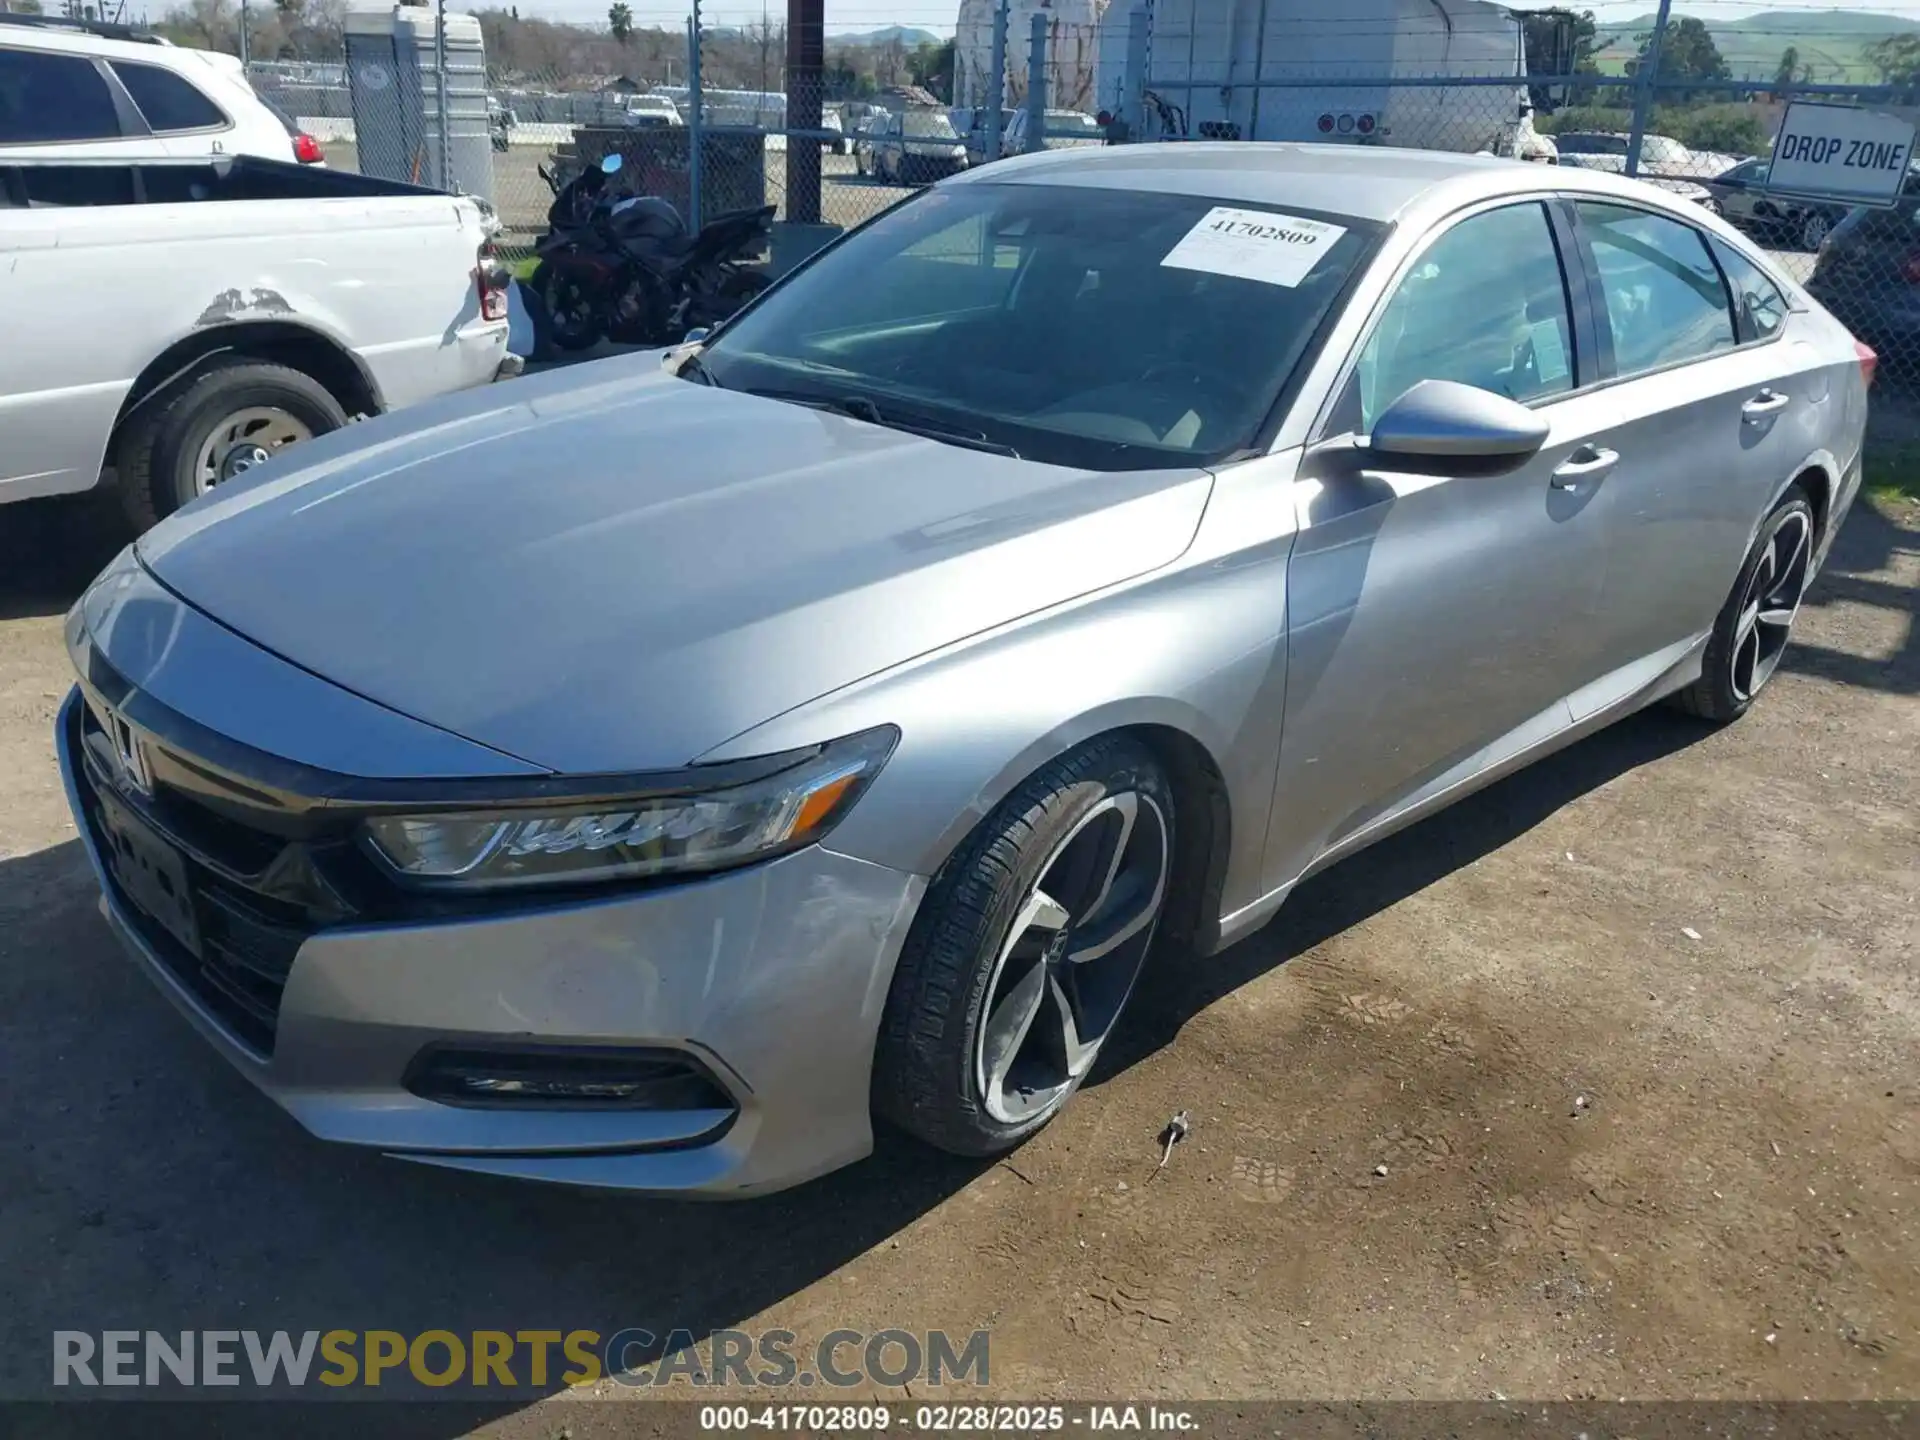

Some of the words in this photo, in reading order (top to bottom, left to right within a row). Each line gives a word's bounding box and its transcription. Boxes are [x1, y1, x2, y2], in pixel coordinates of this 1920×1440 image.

[1782, 134, 1842, 164] DROP
[1843, 140, 1905, 170] ZONE
[1209, 219, 1318, 245] 41702809
